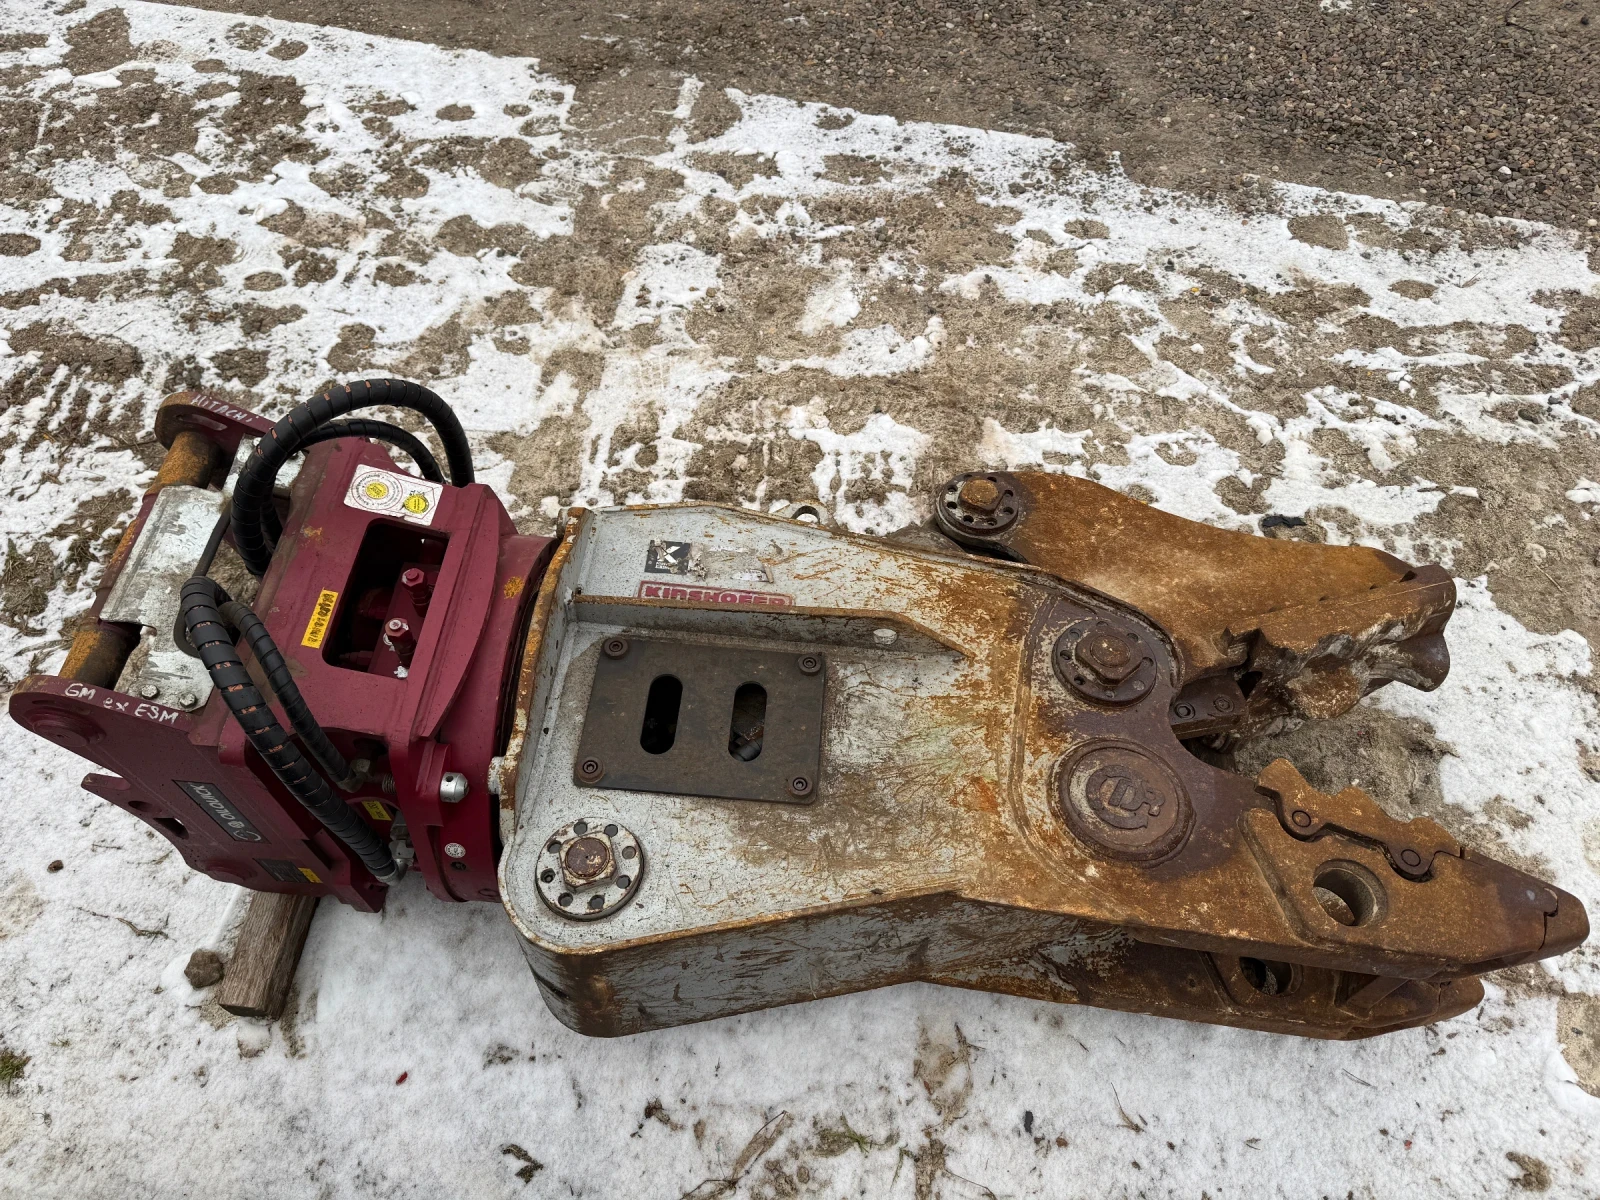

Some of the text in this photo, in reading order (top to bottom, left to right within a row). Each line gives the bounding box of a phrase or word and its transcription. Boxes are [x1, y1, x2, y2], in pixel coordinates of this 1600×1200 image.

[64, 682, 180, 725] GM ex ESM
